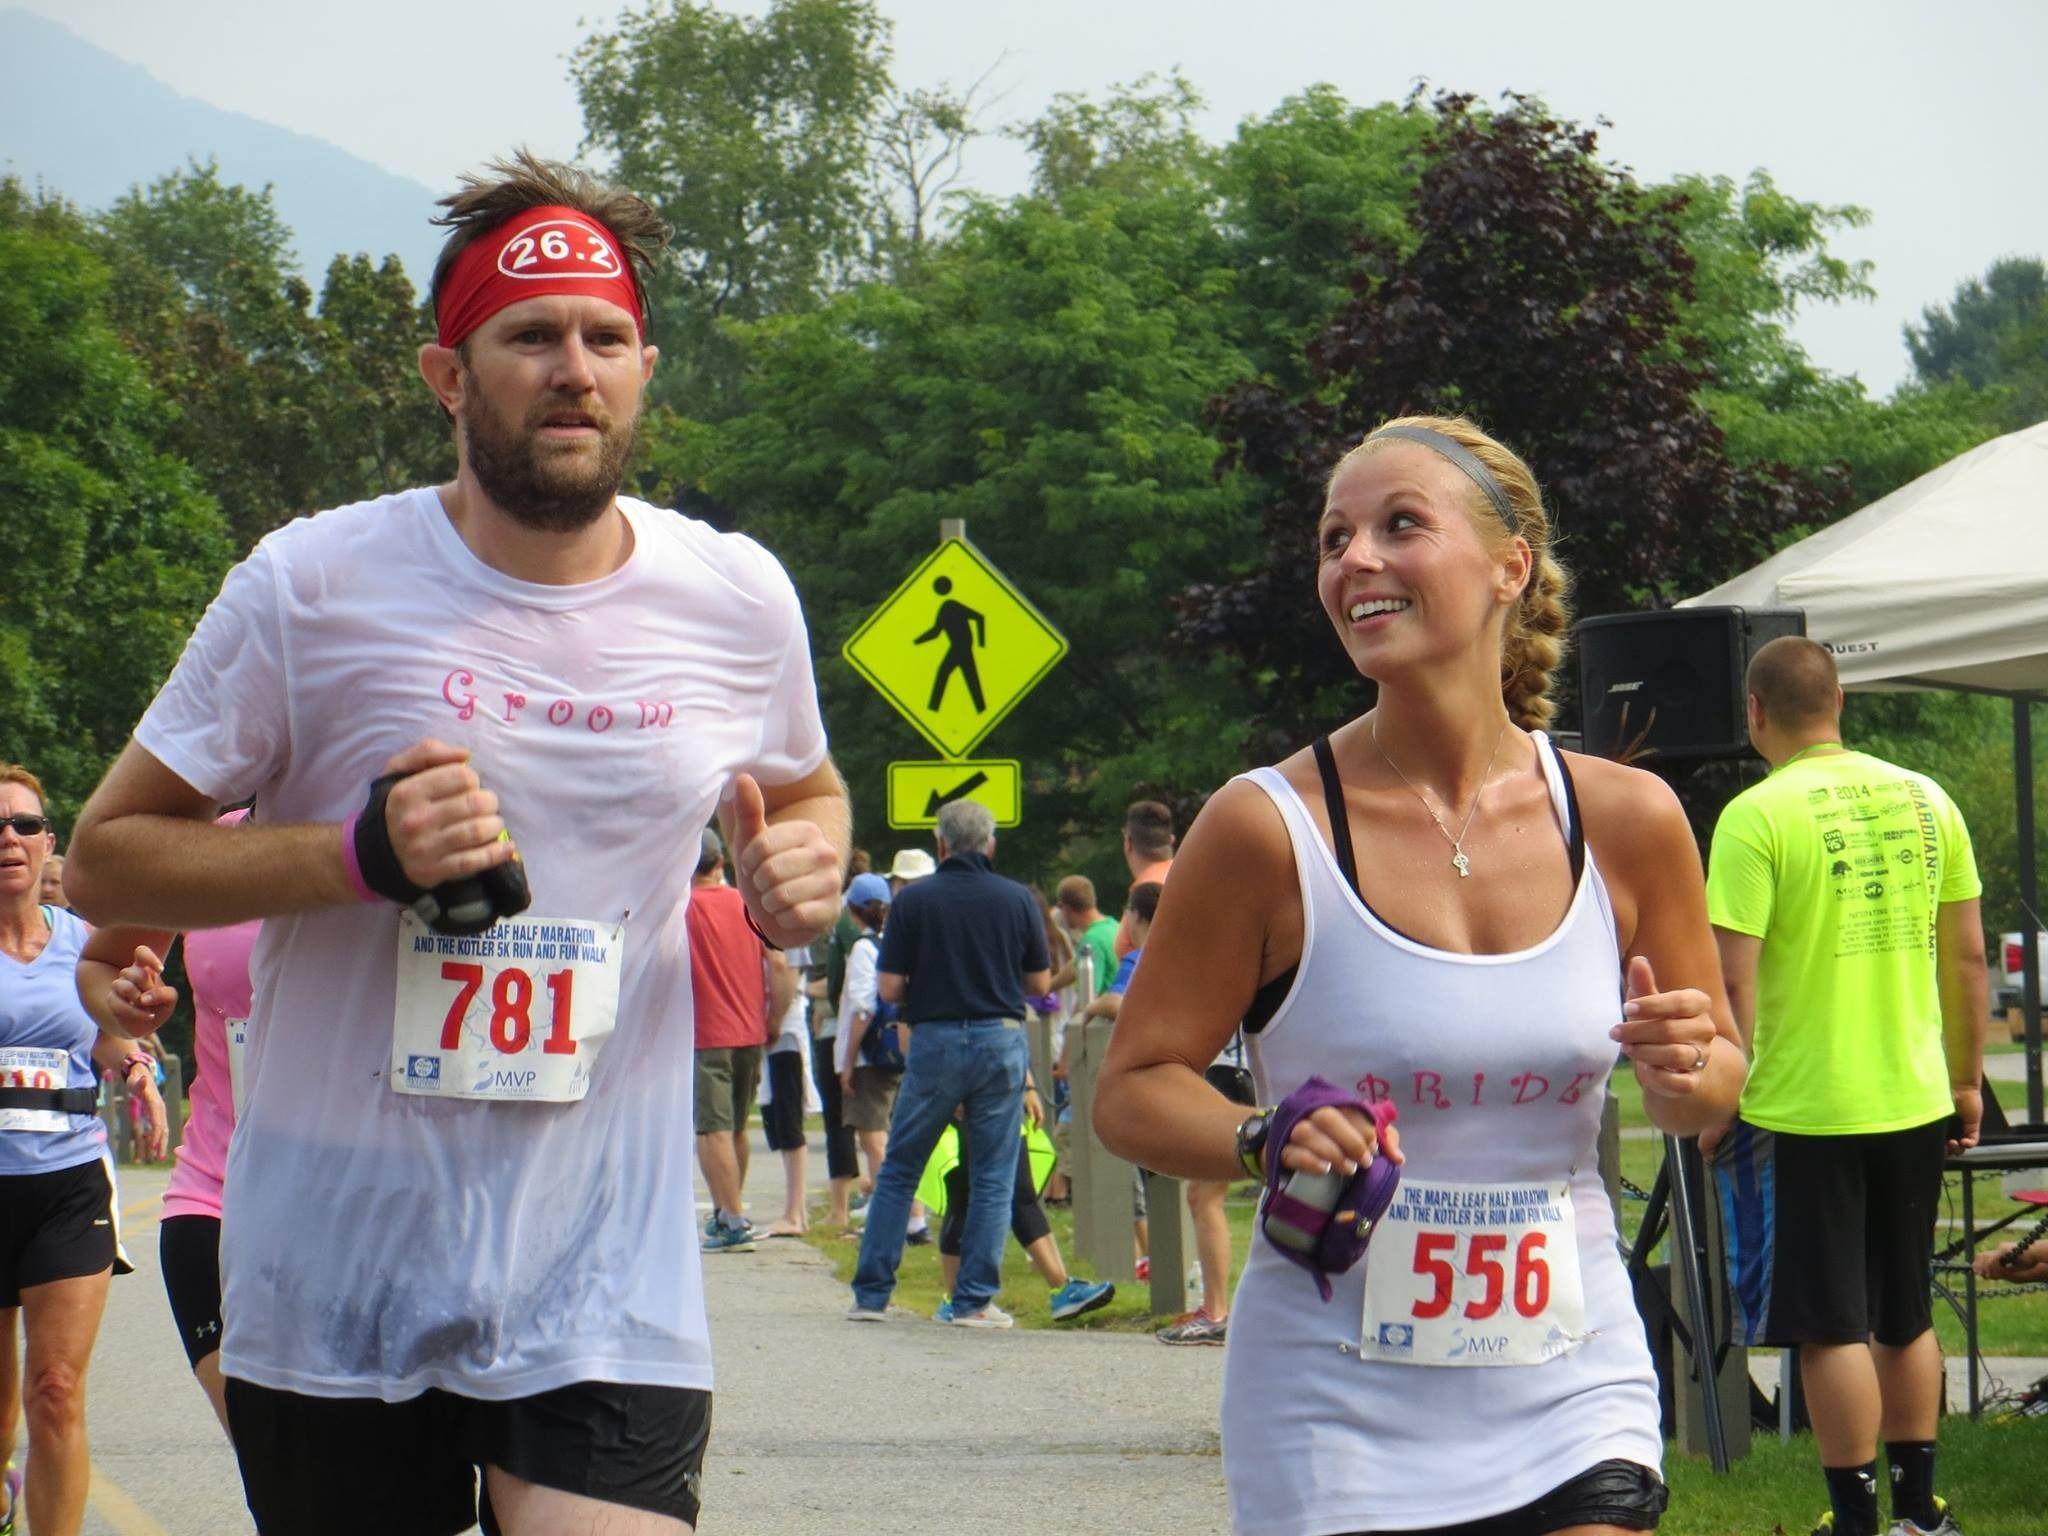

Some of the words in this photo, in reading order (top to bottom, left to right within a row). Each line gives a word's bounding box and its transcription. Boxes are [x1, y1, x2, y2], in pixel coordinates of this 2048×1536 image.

[509, 230, 613, 270] 26.2
[442, 668, 674, 733] Groom
[1834, 784, 1872, 800] 2014
[1904, 779, 1938, 881] GUARDIANS
[485, 924, 510, 940] LEAF
[512, 924, 538, 941] HALF
[540, 926, 595, 944] MARATHON
[414, 936, 434, 953] AND
[437, 937, 455, 955] THE
[456, 939, 494, 957] KOTLER
[497, 941, 510, 958] 5K
[512, 942, 533, 959] RUN
[535, 944, 556, 960] AND
[559, 944, 579, 961] FUN
[582, 945, 607, 963] WALK
[440, 962, 577, 1055] 781
[495, 1071, 537, 1086] MVP
[1404, 1187, 1422, 1204] THE
[1425, 1189, 1460, 1207] MAPLE
[1462, 1191, 1487, 1208] LEAF
[1489, 1190, 1511, 1208] HALF
[1512, 1188, 1549, 1206] MARATHON
[1388, 1203, 1410, 1221] AND
[1413, 1205, 1431, 1223] THE
[1433, 1207, 1471, 1225] KOTLER
[1473, 1209, 1486, 1226] 5K
[1489, 1208, 1507, 1225] RUN
[1510, 1207, 1526, 1224] AND
[1411, 1231, 1550, 1321] 556
[1468, 1336, 1509, 1353] MVP
